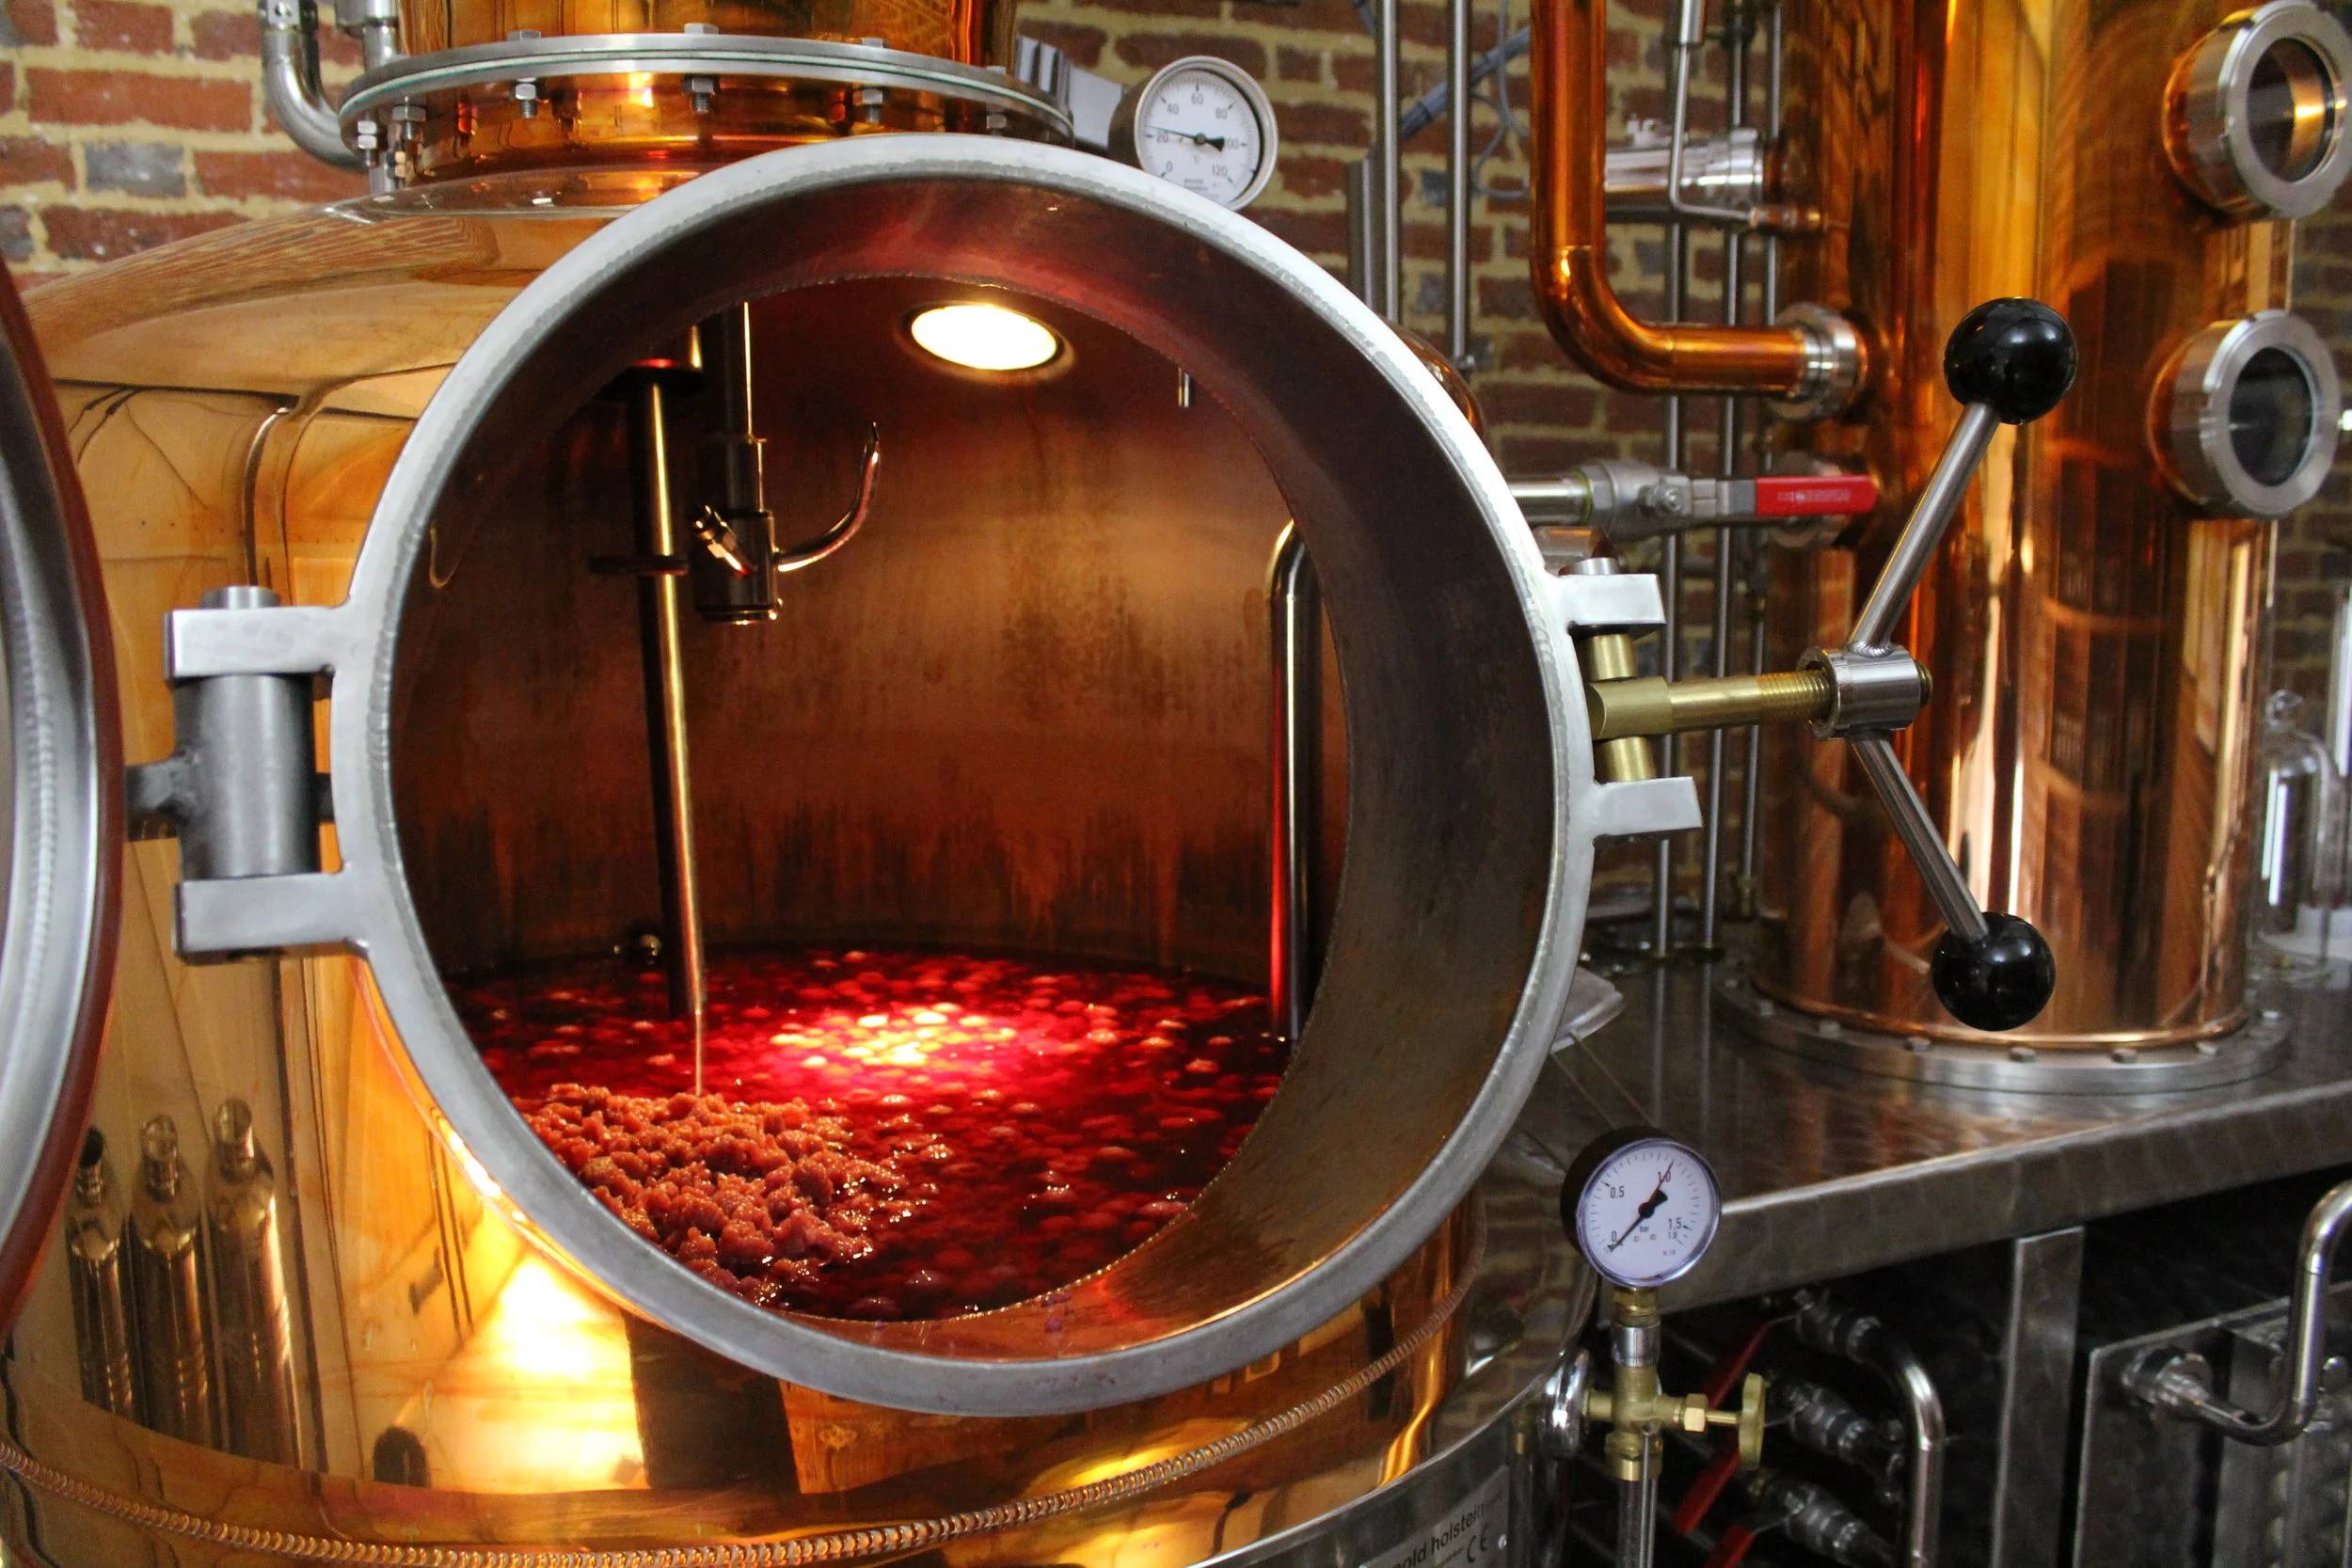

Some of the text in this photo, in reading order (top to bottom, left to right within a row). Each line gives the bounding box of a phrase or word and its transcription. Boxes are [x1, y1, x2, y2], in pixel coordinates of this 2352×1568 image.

[1191, 93, 1204, 104] 60
[1167, 103, 1180, 115] 40
[1216, 108, 1228, 119] 80
[1156, 132, 1168, 143] 20
[1212, 165, 1228, 177] 120
[1610, 1186, 1625, 1199] 0.5
[1639, 1225, 1650, 1233] bar
[1668, 1217, 1682, 1229] 1.5
[1611, 1230, 1617, 1243] 0
[1430, 1503, 1485, 1554] holstein
